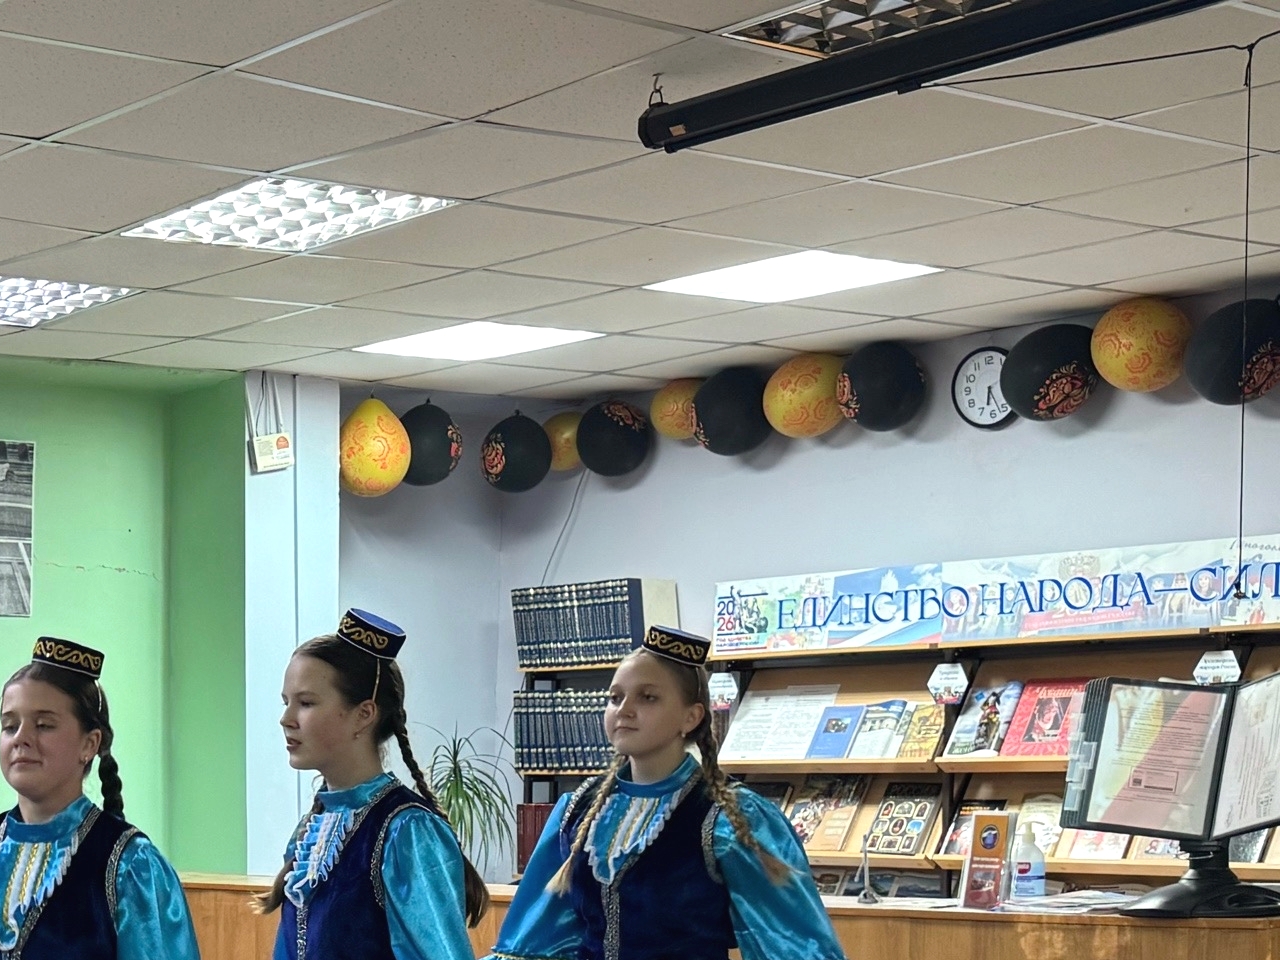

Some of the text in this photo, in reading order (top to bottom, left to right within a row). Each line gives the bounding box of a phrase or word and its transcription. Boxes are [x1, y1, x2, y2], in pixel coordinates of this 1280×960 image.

[985, 356, 994, 365] 12
[974, 362, 981, 371] 11
[965, 373, 976, 383] 10
[964, 386, 972, 395] 9
[967, 398, 976, 408] 8
[1001, 403, 1009, 412] 5
[978, 406, 985, 416] 7
[990, 410, 997, 419] 6
[777, 586, 970, 631] ЕДИНСТВО
